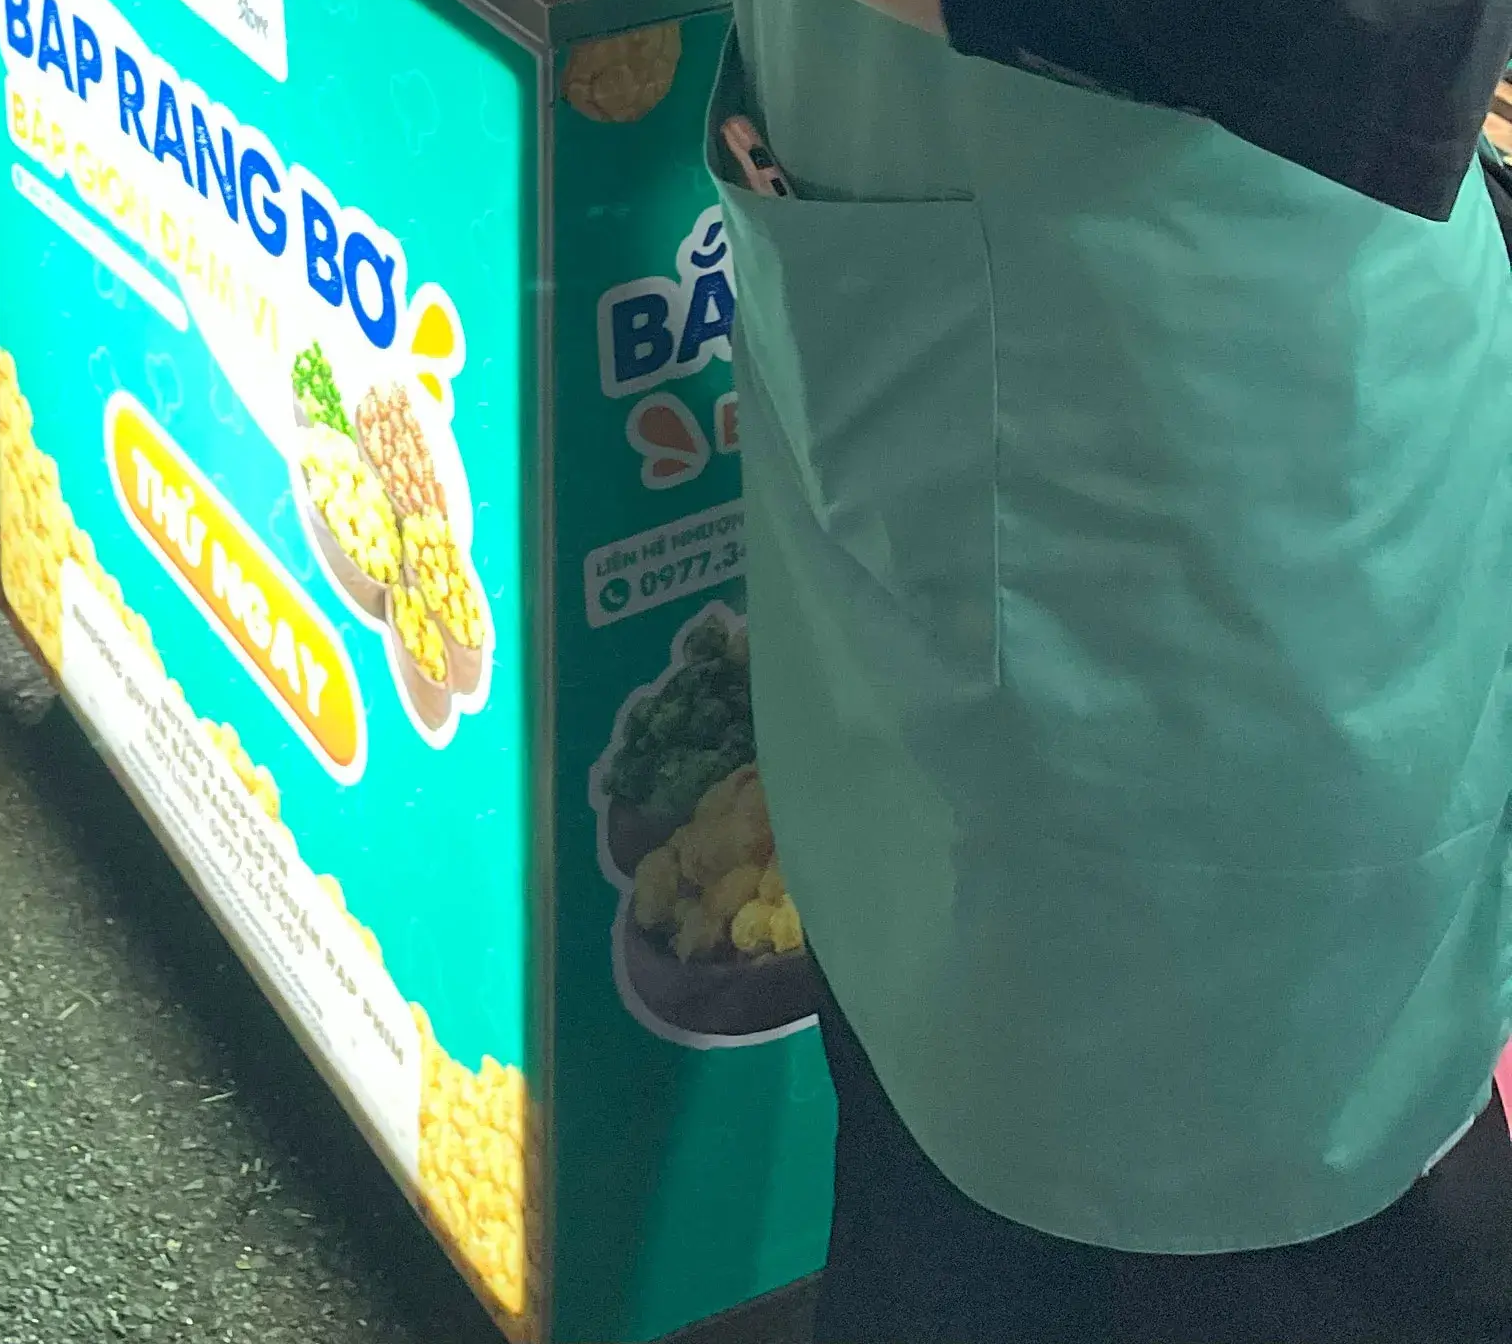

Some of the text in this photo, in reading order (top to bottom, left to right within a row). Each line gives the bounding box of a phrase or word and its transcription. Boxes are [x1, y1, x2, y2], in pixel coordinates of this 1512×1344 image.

[115, 46, 288, 258] RANG
[301, 188, 398, 350] BƠ
[610, 220, 738, 384] BẮ
[212, 538, 329, 718] NGAY
